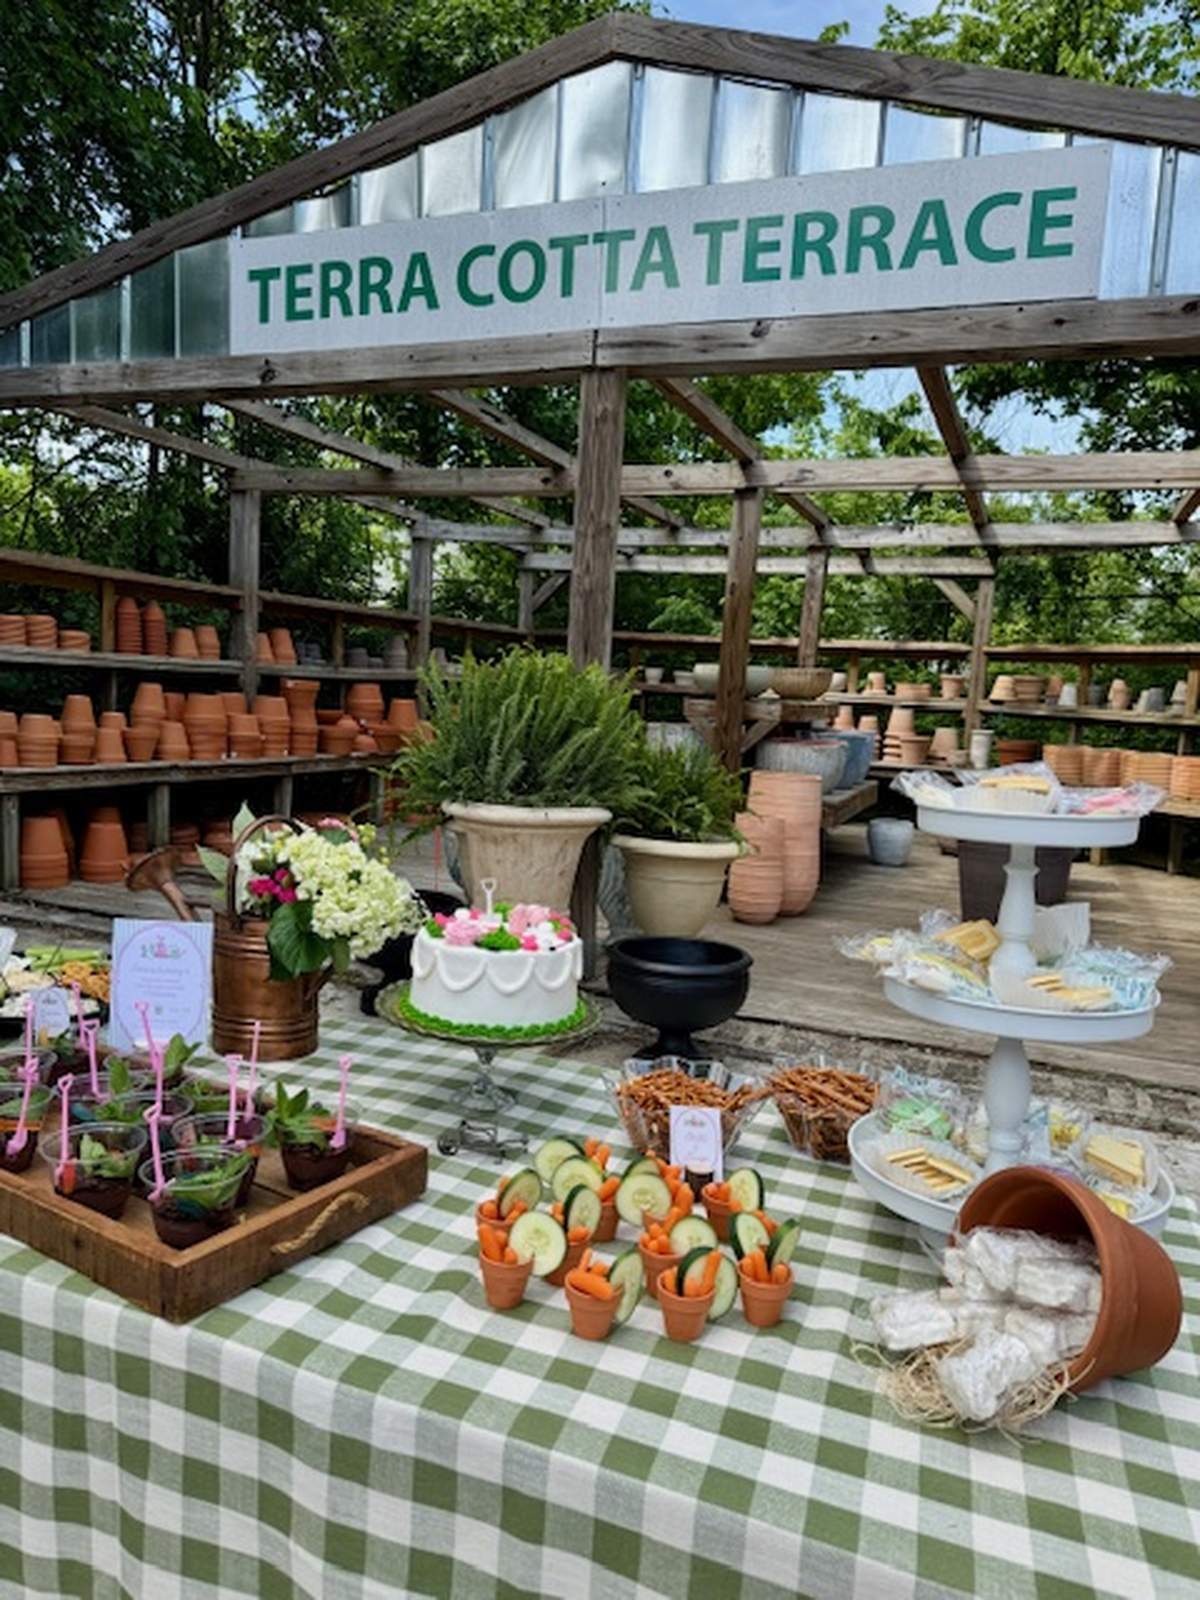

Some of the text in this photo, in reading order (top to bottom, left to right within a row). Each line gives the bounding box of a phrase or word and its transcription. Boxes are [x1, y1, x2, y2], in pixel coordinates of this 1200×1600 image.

[247, 186, 1078, 325] TERRA COTTA TERRACE
